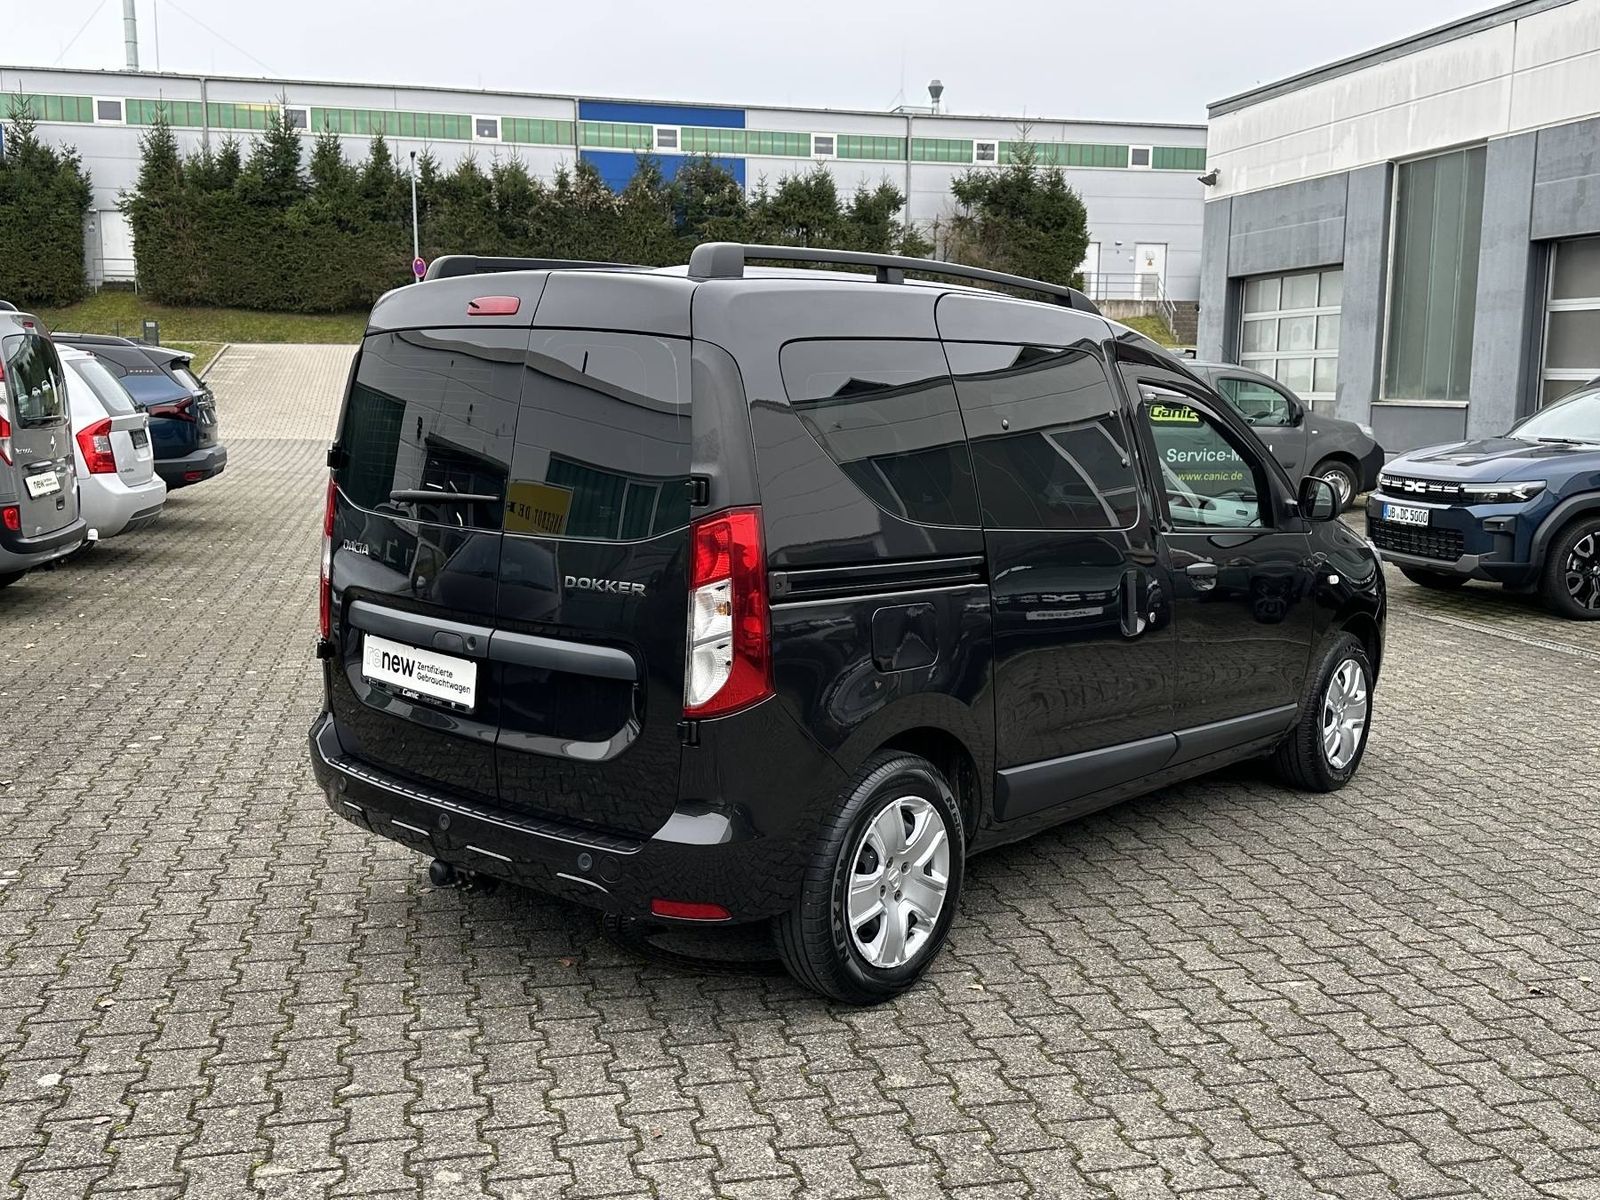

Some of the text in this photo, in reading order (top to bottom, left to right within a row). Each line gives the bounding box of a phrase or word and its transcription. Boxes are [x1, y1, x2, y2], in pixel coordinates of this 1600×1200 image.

[1178, 470, 1244, 481] www.canic.de
[564, 575, 648, 597] DOKKER
[417, 661, 454, 679] Zertifizierte
[416, 671, 471, 694] Gebrauchtwagen
